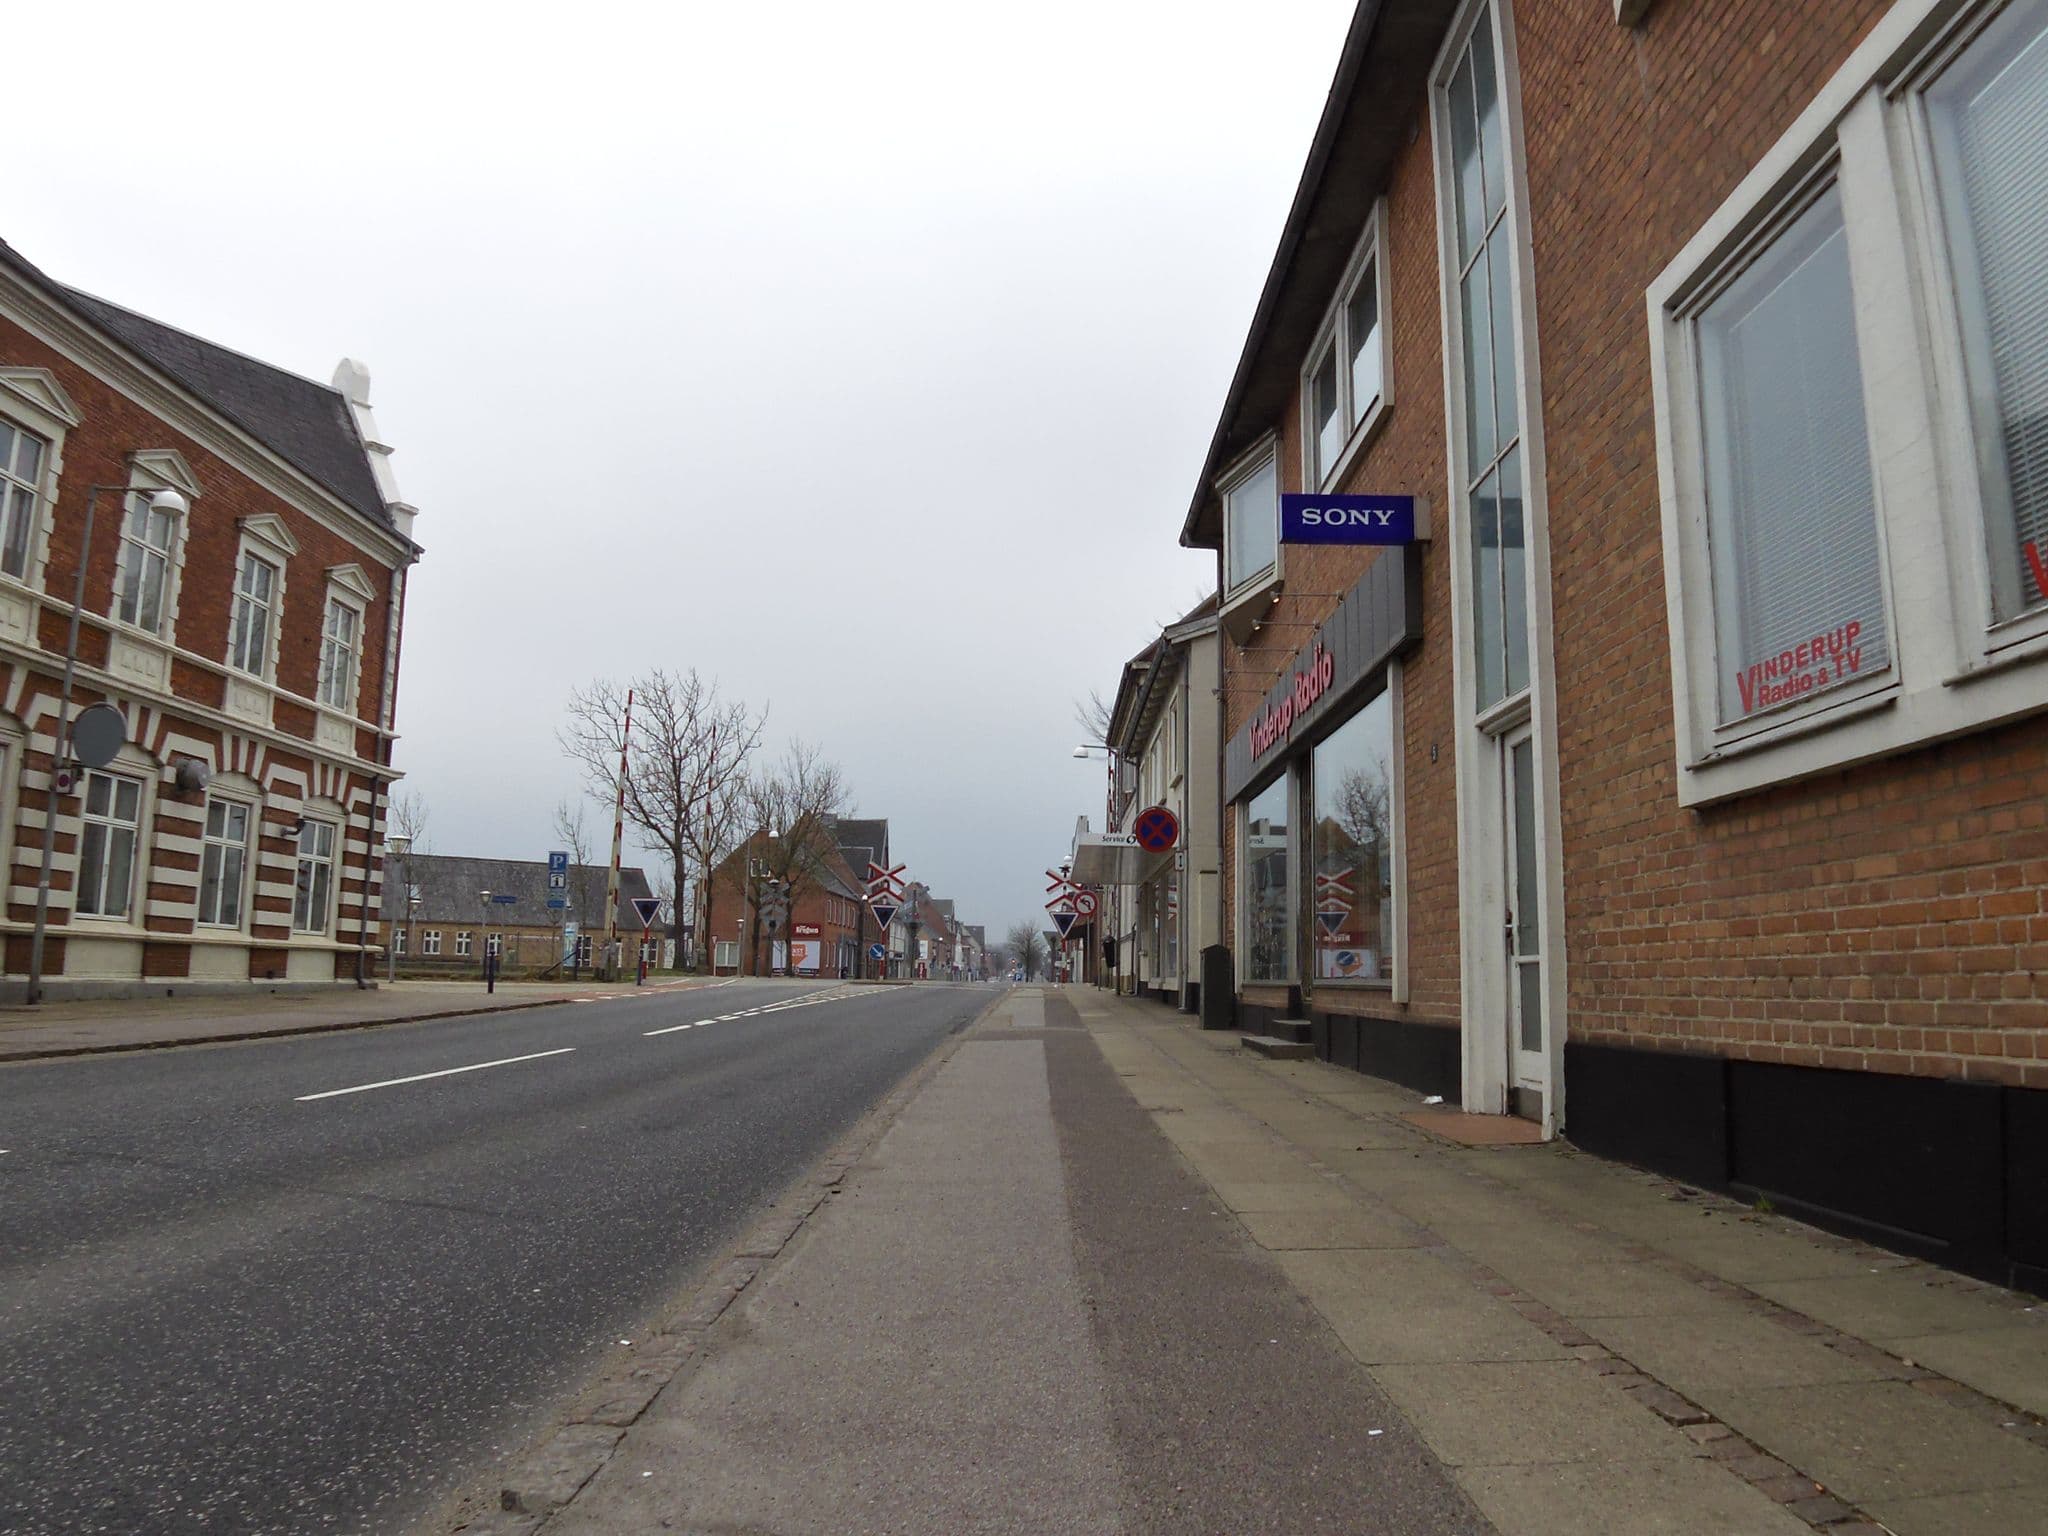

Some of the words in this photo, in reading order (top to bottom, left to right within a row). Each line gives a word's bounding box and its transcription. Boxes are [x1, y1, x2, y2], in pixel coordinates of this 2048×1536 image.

[1301, 507, 1395, 526] SONY
[1736, 621, 1861, 713] VINDERUP
[1758, 671, 1813, 708] Radio
[1817, 667, 1829, 686] &
[1832, 647, 1860, 679] TV
[1249, 694, 1294, 762] Vinderup
[1294, 641, 1335, 719] Radio
[1102, 835, 1125, 843] Service
[552, 855, 564, 869] P
